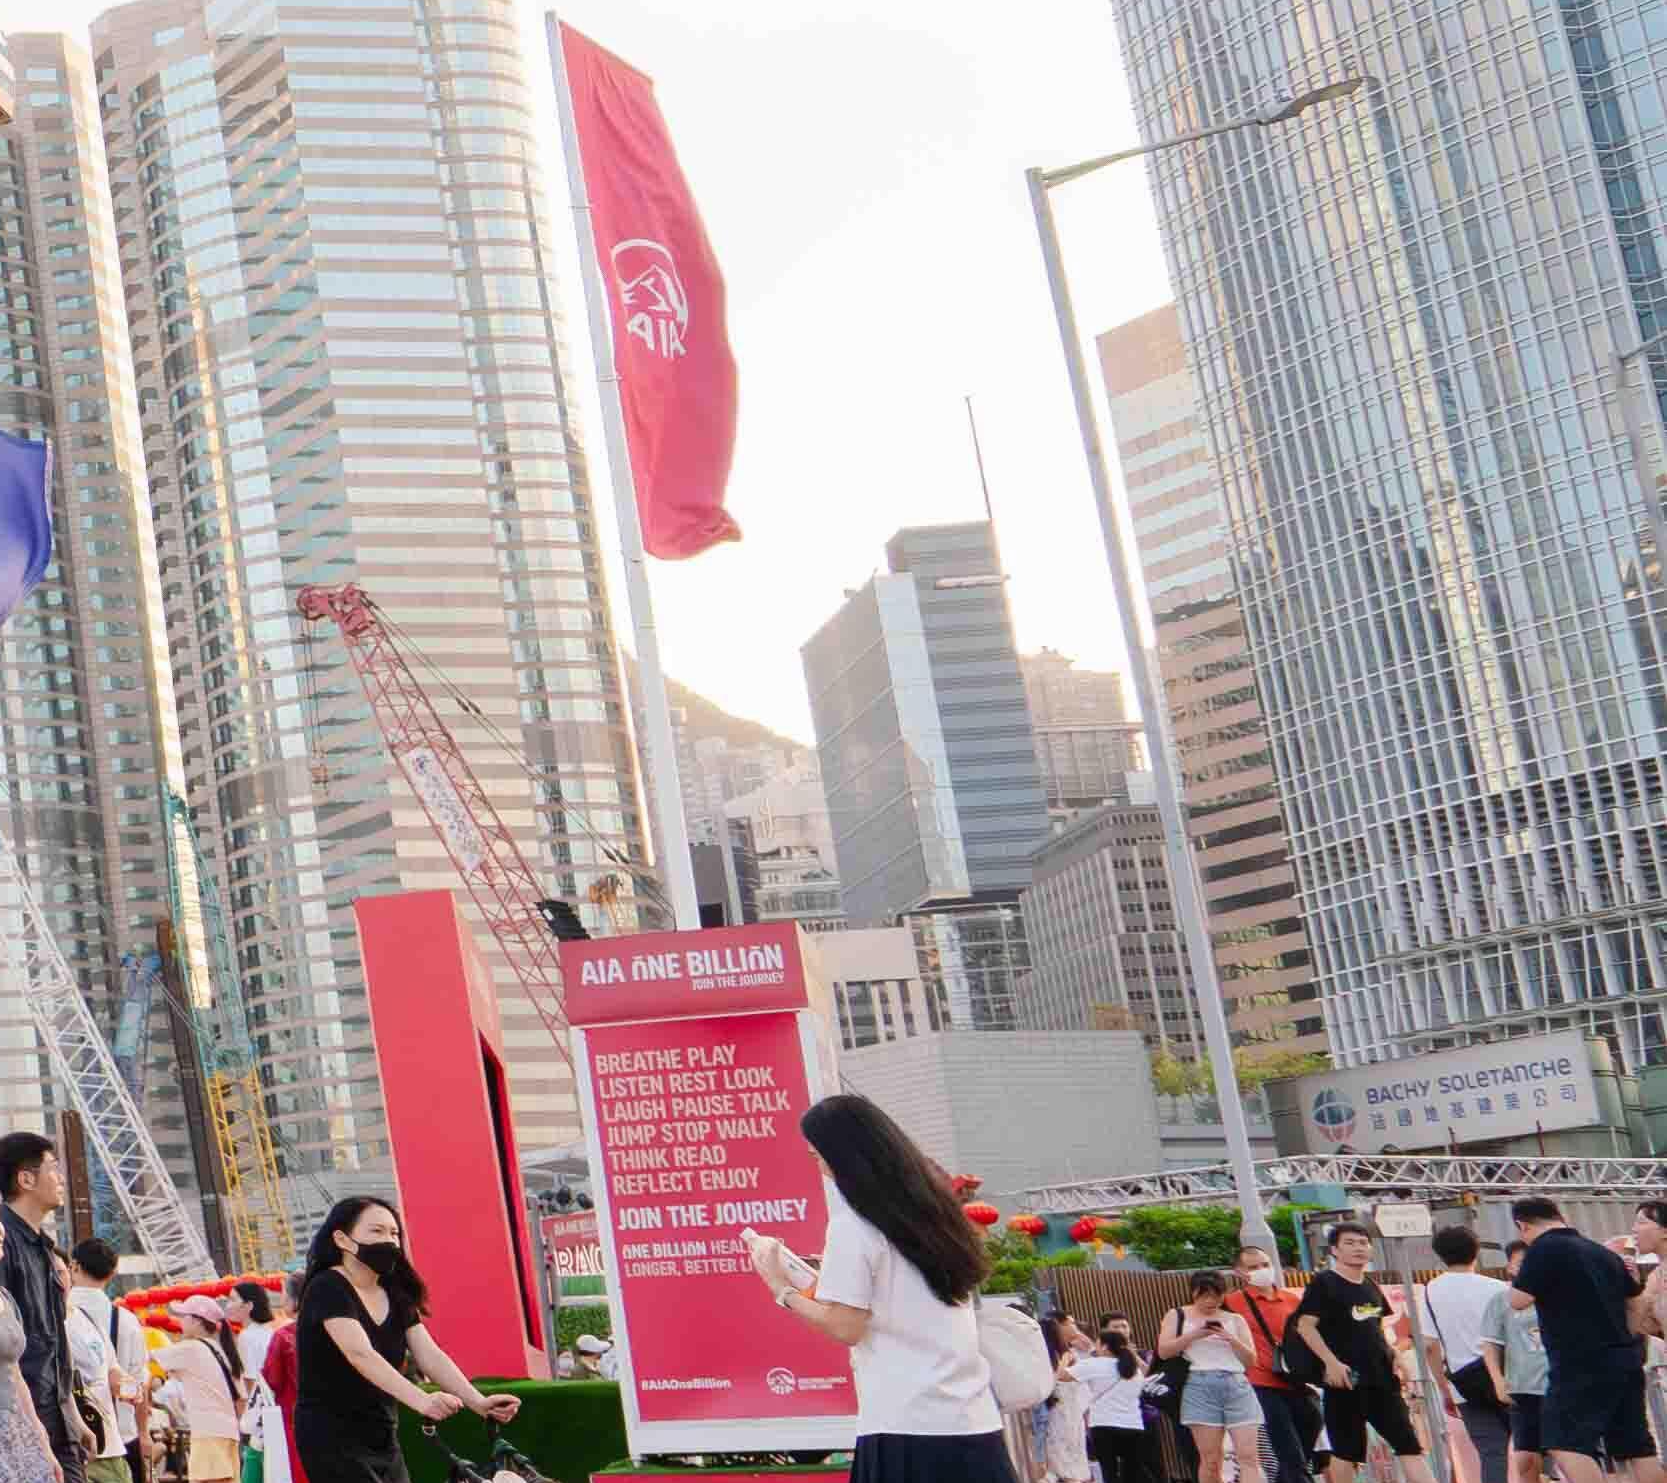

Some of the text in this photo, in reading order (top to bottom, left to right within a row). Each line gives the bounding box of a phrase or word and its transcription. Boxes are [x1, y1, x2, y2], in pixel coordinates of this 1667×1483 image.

[581, 958, 626, 986] AIA
[717, 975, 738, 989] THE
[739, 971, 785, 987] JOURNEY
[596, 1044, 736, 1075] BREATHE PLAY
[600, 1067, 776, 1099] LISTEN REST LOOK
[1365, 1079, 1432, 1105] BACHY
[602, 1089, 791, 1123] LAUGH PAUSE TALK
[606, 1116, 776, 1148] JUMP STOP WALK
[607, 1144, 727, 1173] THINK READ
[613, 1167, 760, 1196] REFLECT ENJOY
[617, 1207, 662, 1231] JOIN
[666, 1204, 710, 1228] THE
[714, 1198, 808, 1226] JOURNEY
[685, 1258, 738, 1275] BETTER
